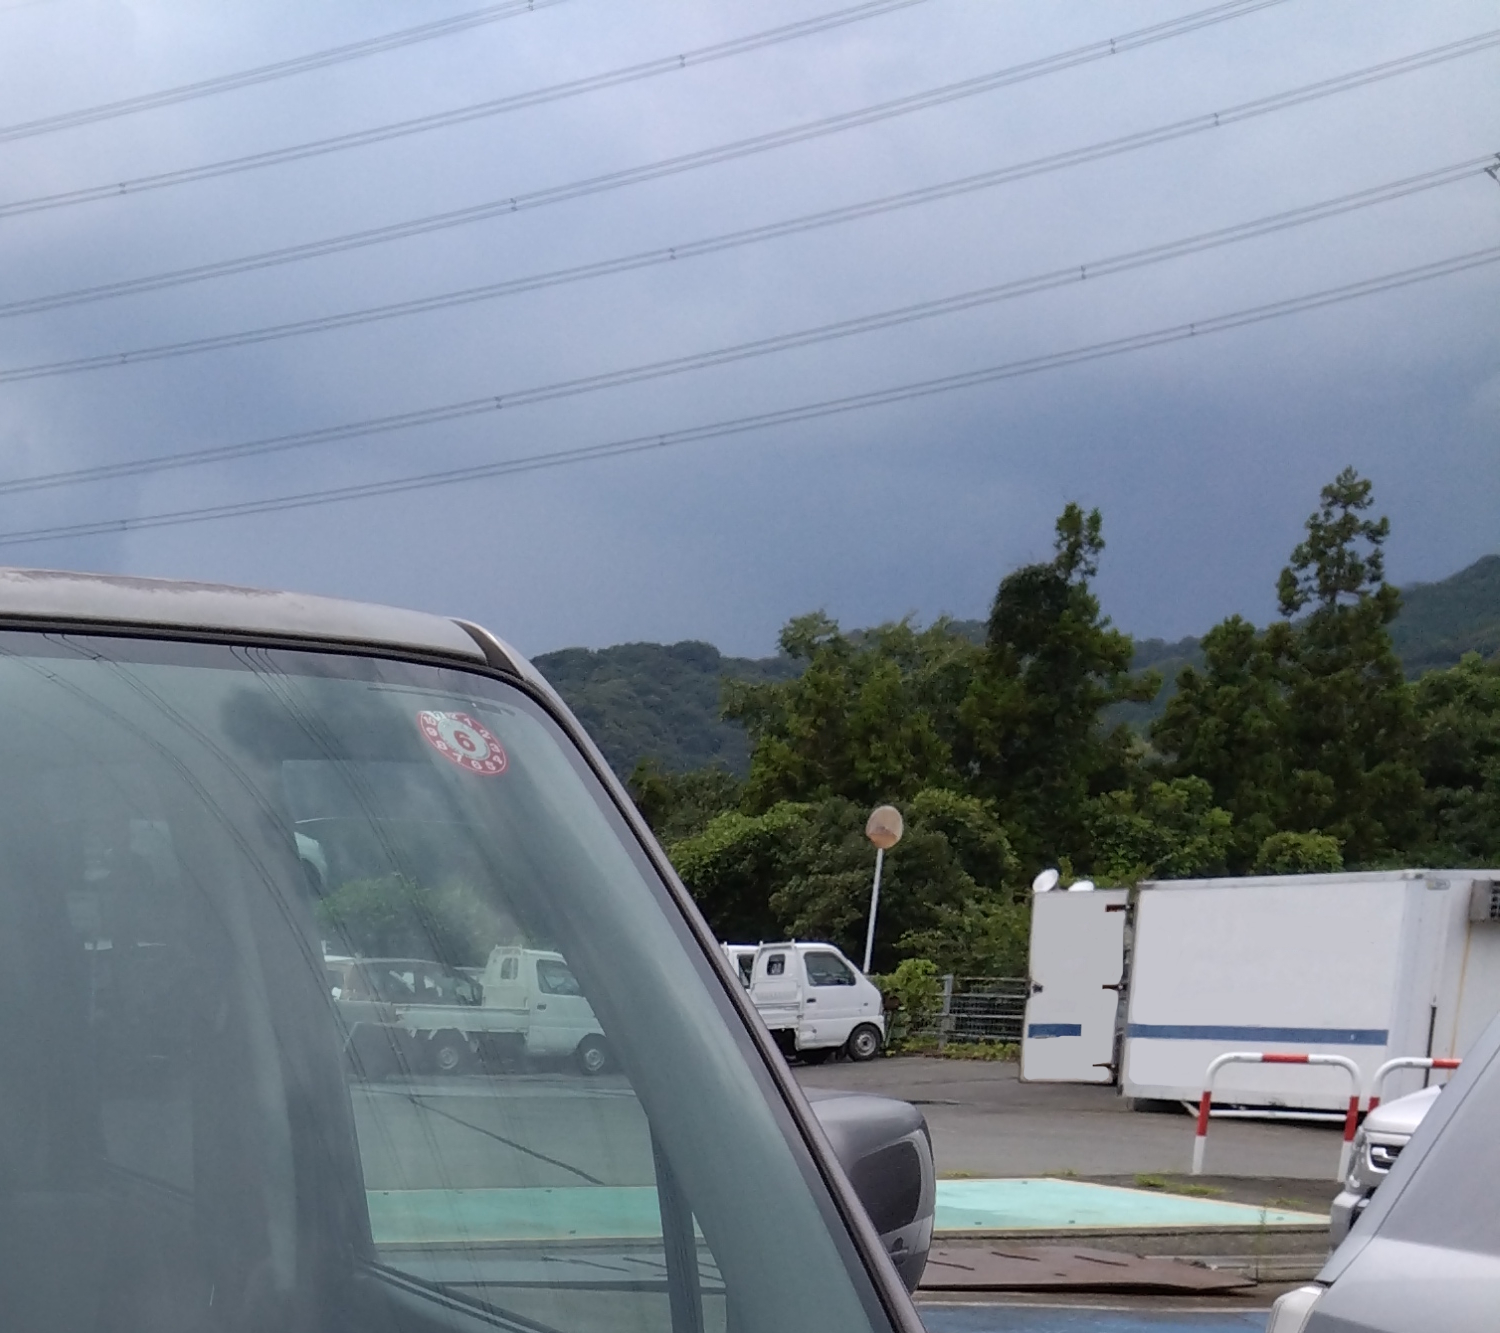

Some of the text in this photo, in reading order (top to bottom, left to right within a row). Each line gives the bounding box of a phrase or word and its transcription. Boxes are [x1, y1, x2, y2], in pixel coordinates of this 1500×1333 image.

[480, 729, 491, 739] 2
[453, 730, 476, 752] 6
[452, 752, 463, 762] 7
